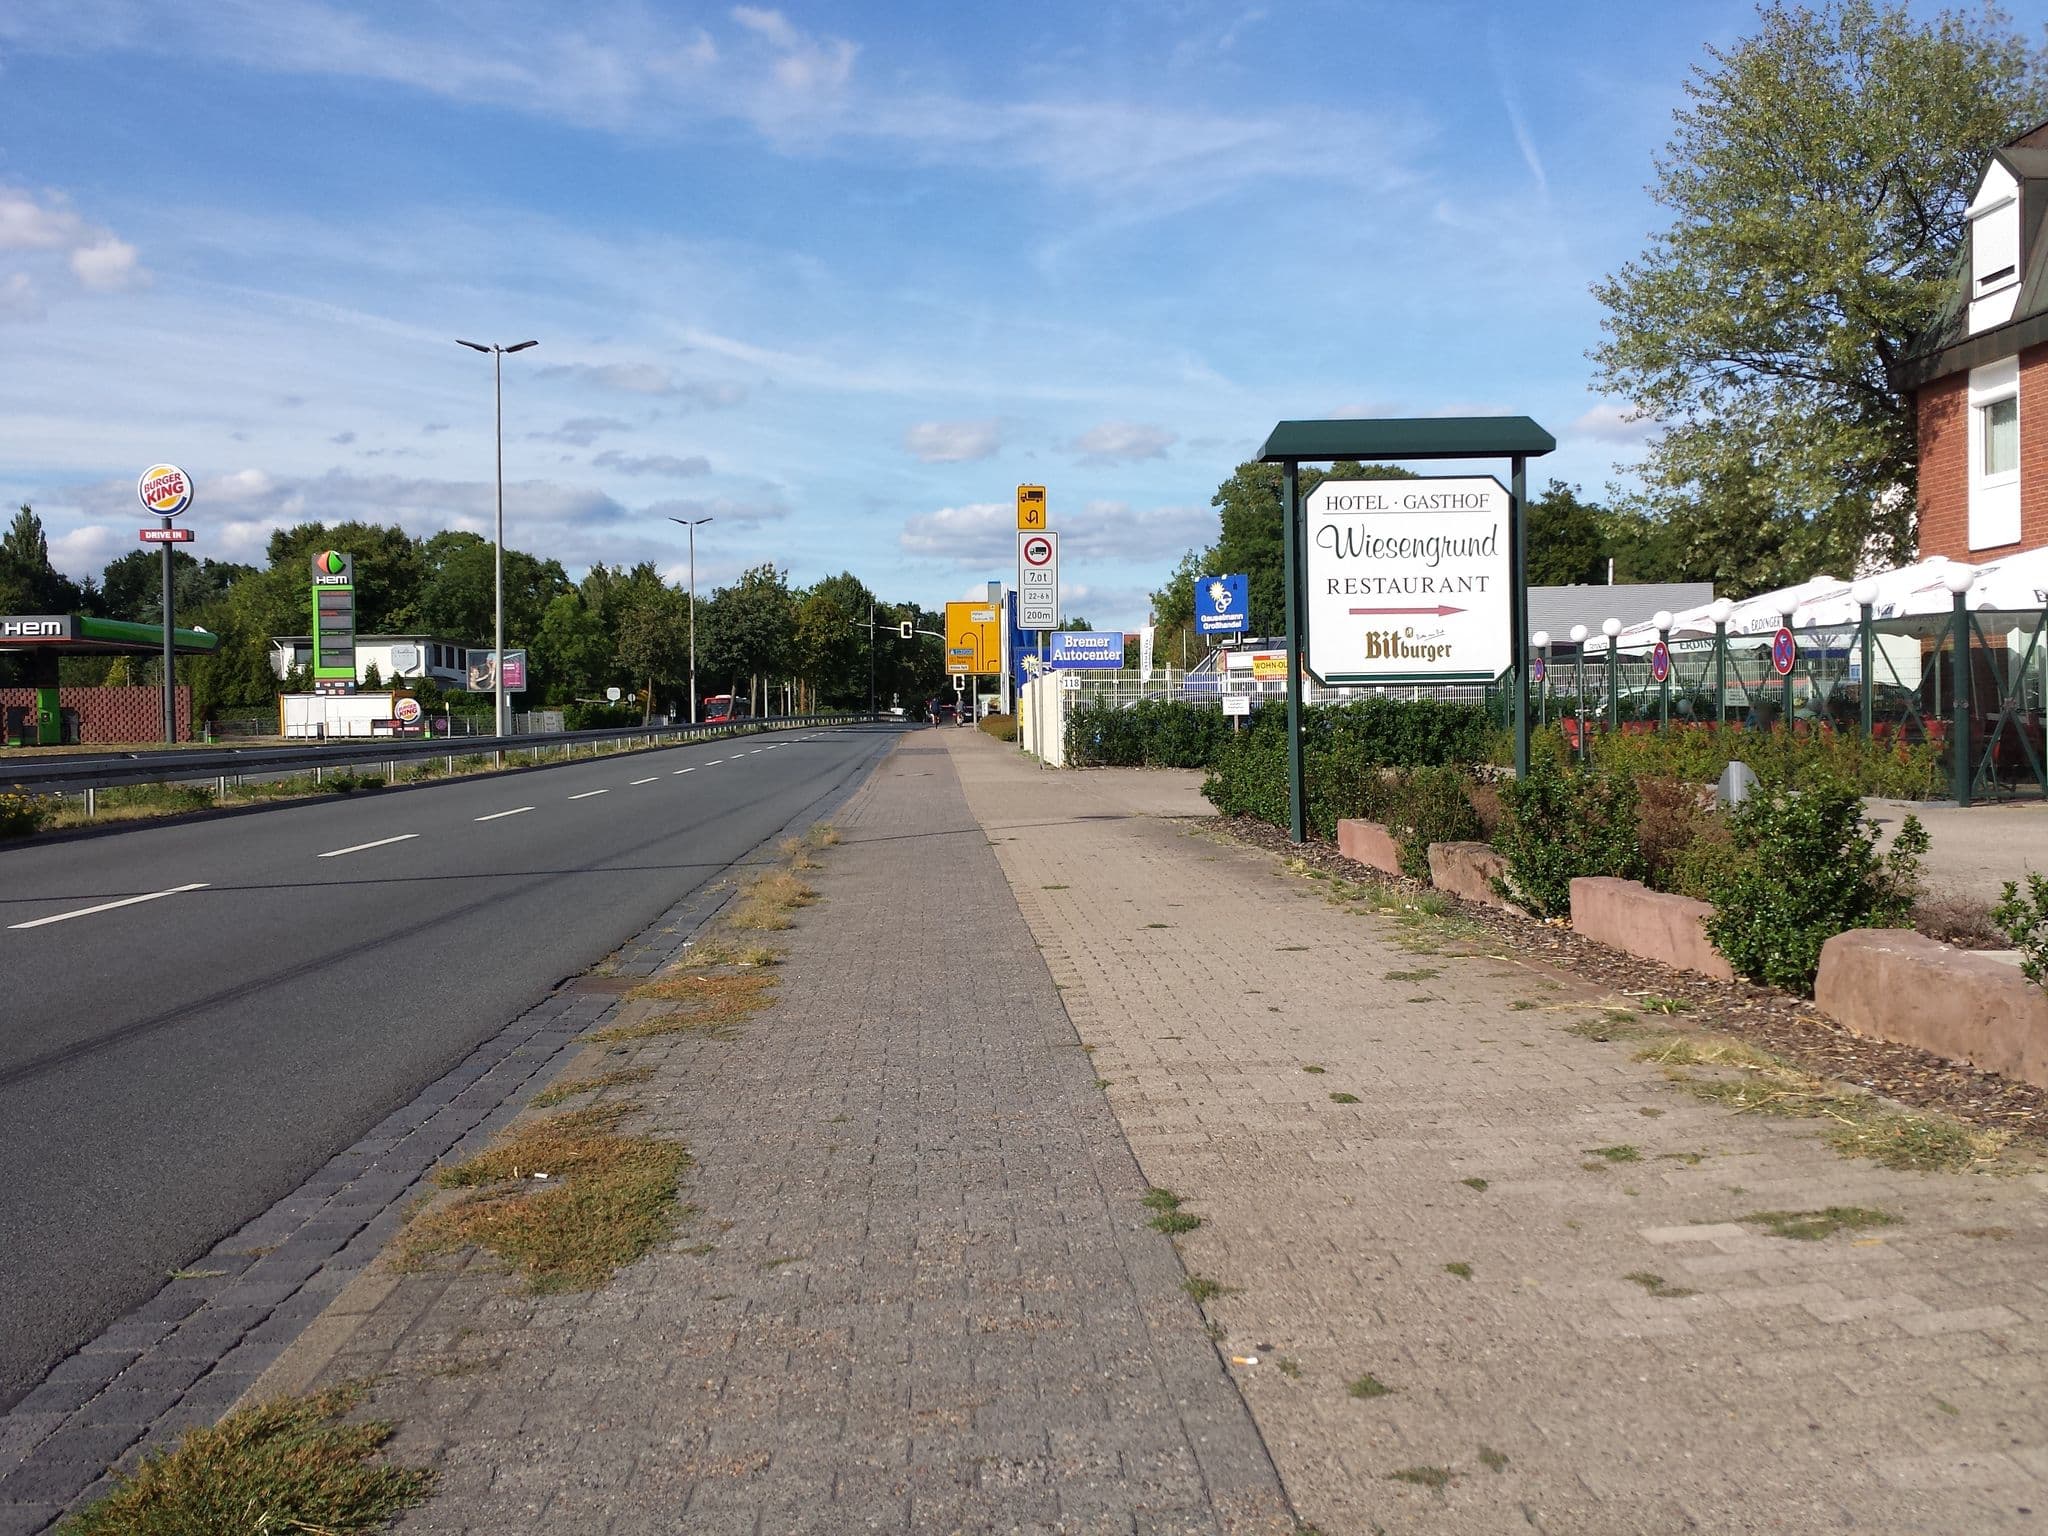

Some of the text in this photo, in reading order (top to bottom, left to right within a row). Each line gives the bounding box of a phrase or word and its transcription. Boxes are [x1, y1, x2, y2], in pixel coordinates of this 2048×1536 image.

[144, 472, 181, 494] BURGER
[146, 481, 185, 505] KING
[1326, 493, 1490, 511] HOTEL GASTHOF
[145, 531, 182, 539] DRIVE IN
[1316, 522, 1499, 568] Wiesengrund
[1327, 575, 1490, 595] RESTAURANT
[1064, 635, 1110, 648] Bremer
[1365, 630, 1452, 662] Bitburger
[1680, 638, 1733, 650] ERDINR
[1052, 648, 1122, 661] Autocenter
[1064, 678, 1080, 688] 118
